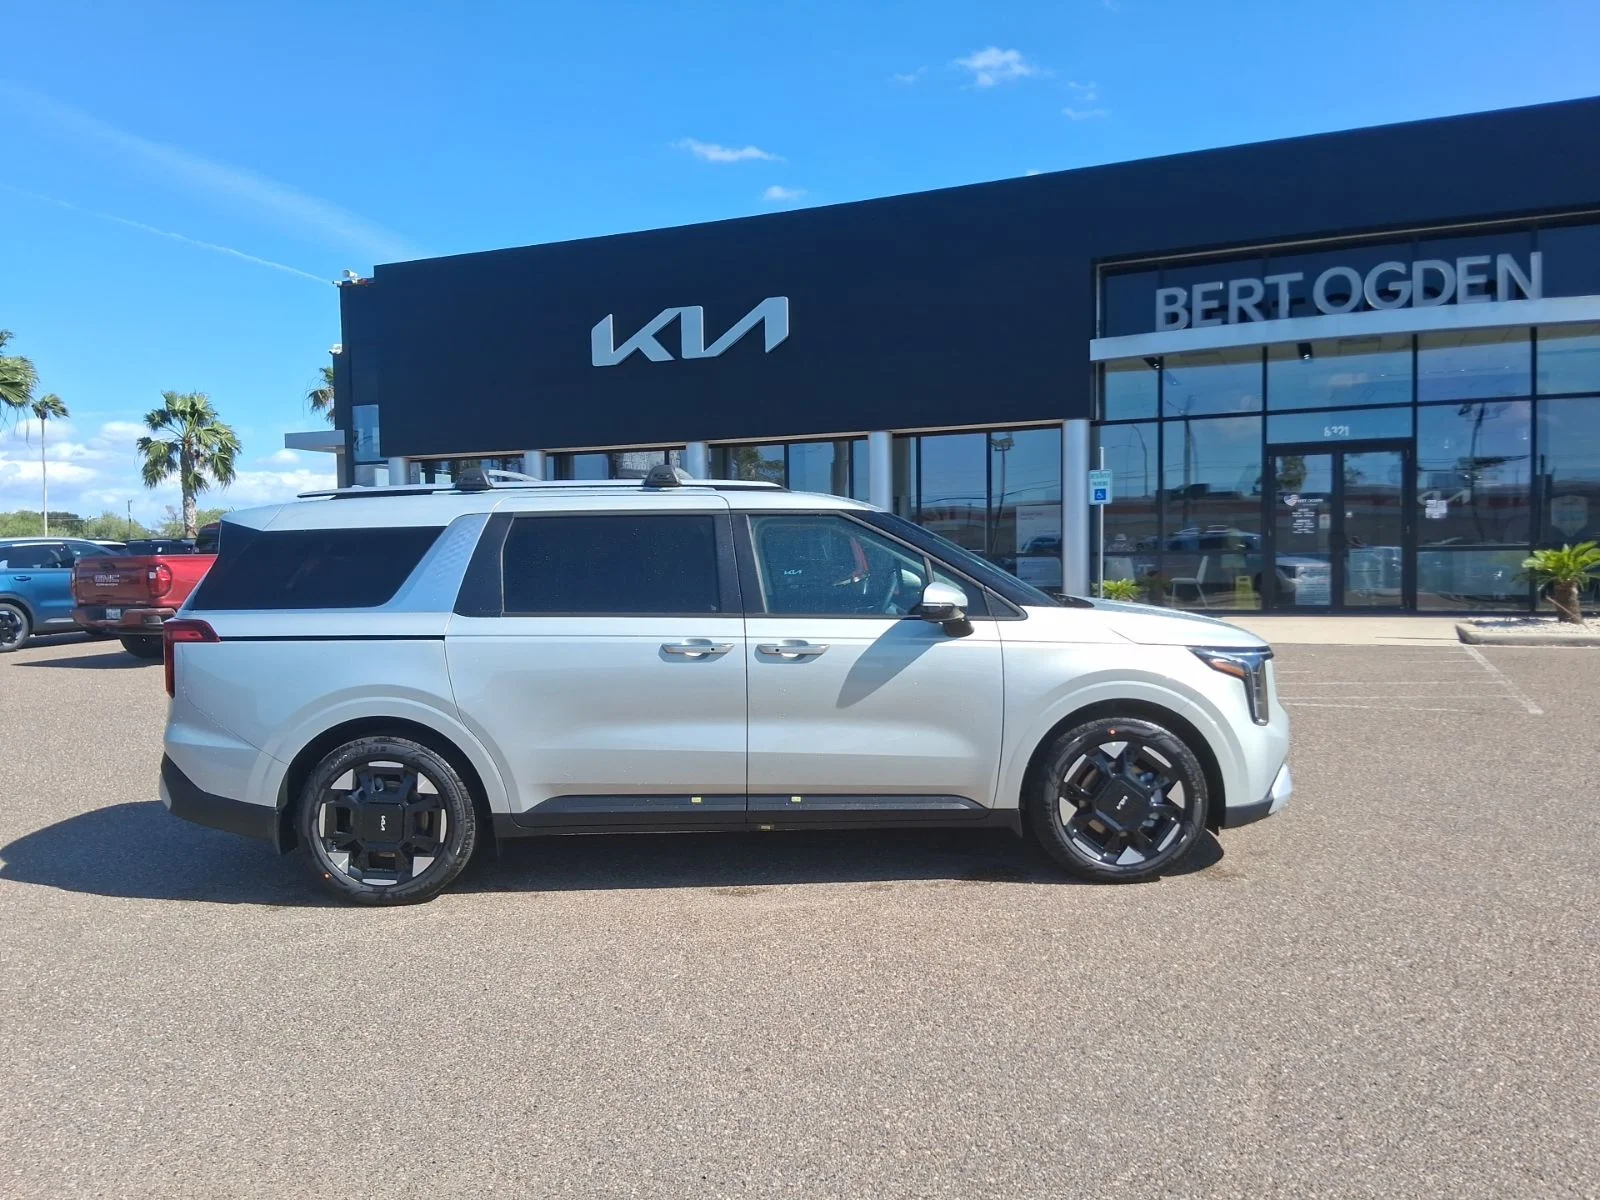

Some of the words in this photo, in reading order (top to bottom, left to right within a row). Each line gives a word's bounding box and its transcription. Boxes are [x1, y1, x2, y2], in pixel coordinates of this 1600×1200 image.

[1155, 272, 1304, 332] BERT
[1313, 251, 1543, 315] OGDEN
[591, 296, 789, 367] KIA
